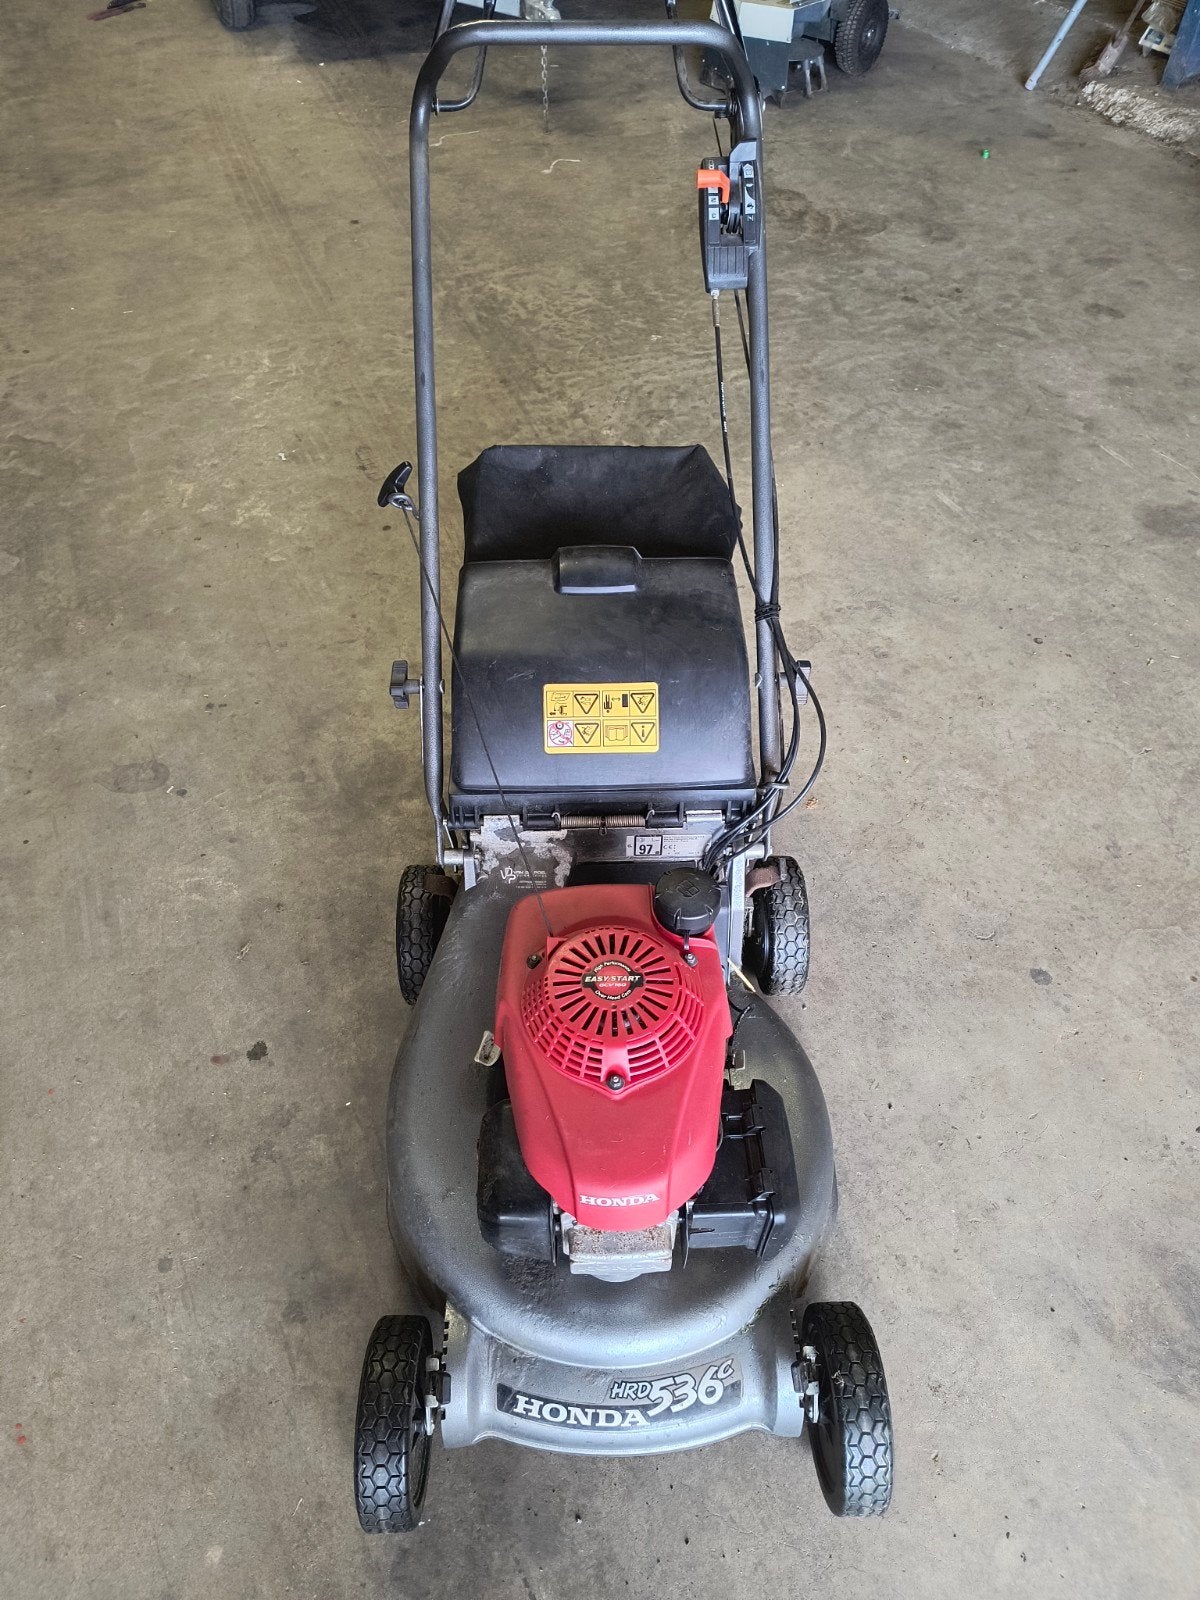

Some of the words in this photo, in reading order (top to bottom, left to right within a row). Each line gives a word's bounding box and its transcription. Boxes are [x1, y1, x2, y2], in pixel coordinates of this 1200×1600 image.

[639, 844, 653, 855] 97
[595, 990, 606, 998] Over
[579, 1193, 660, 1207] HONDA
[512, 1394, 651, 1428] HONDA
